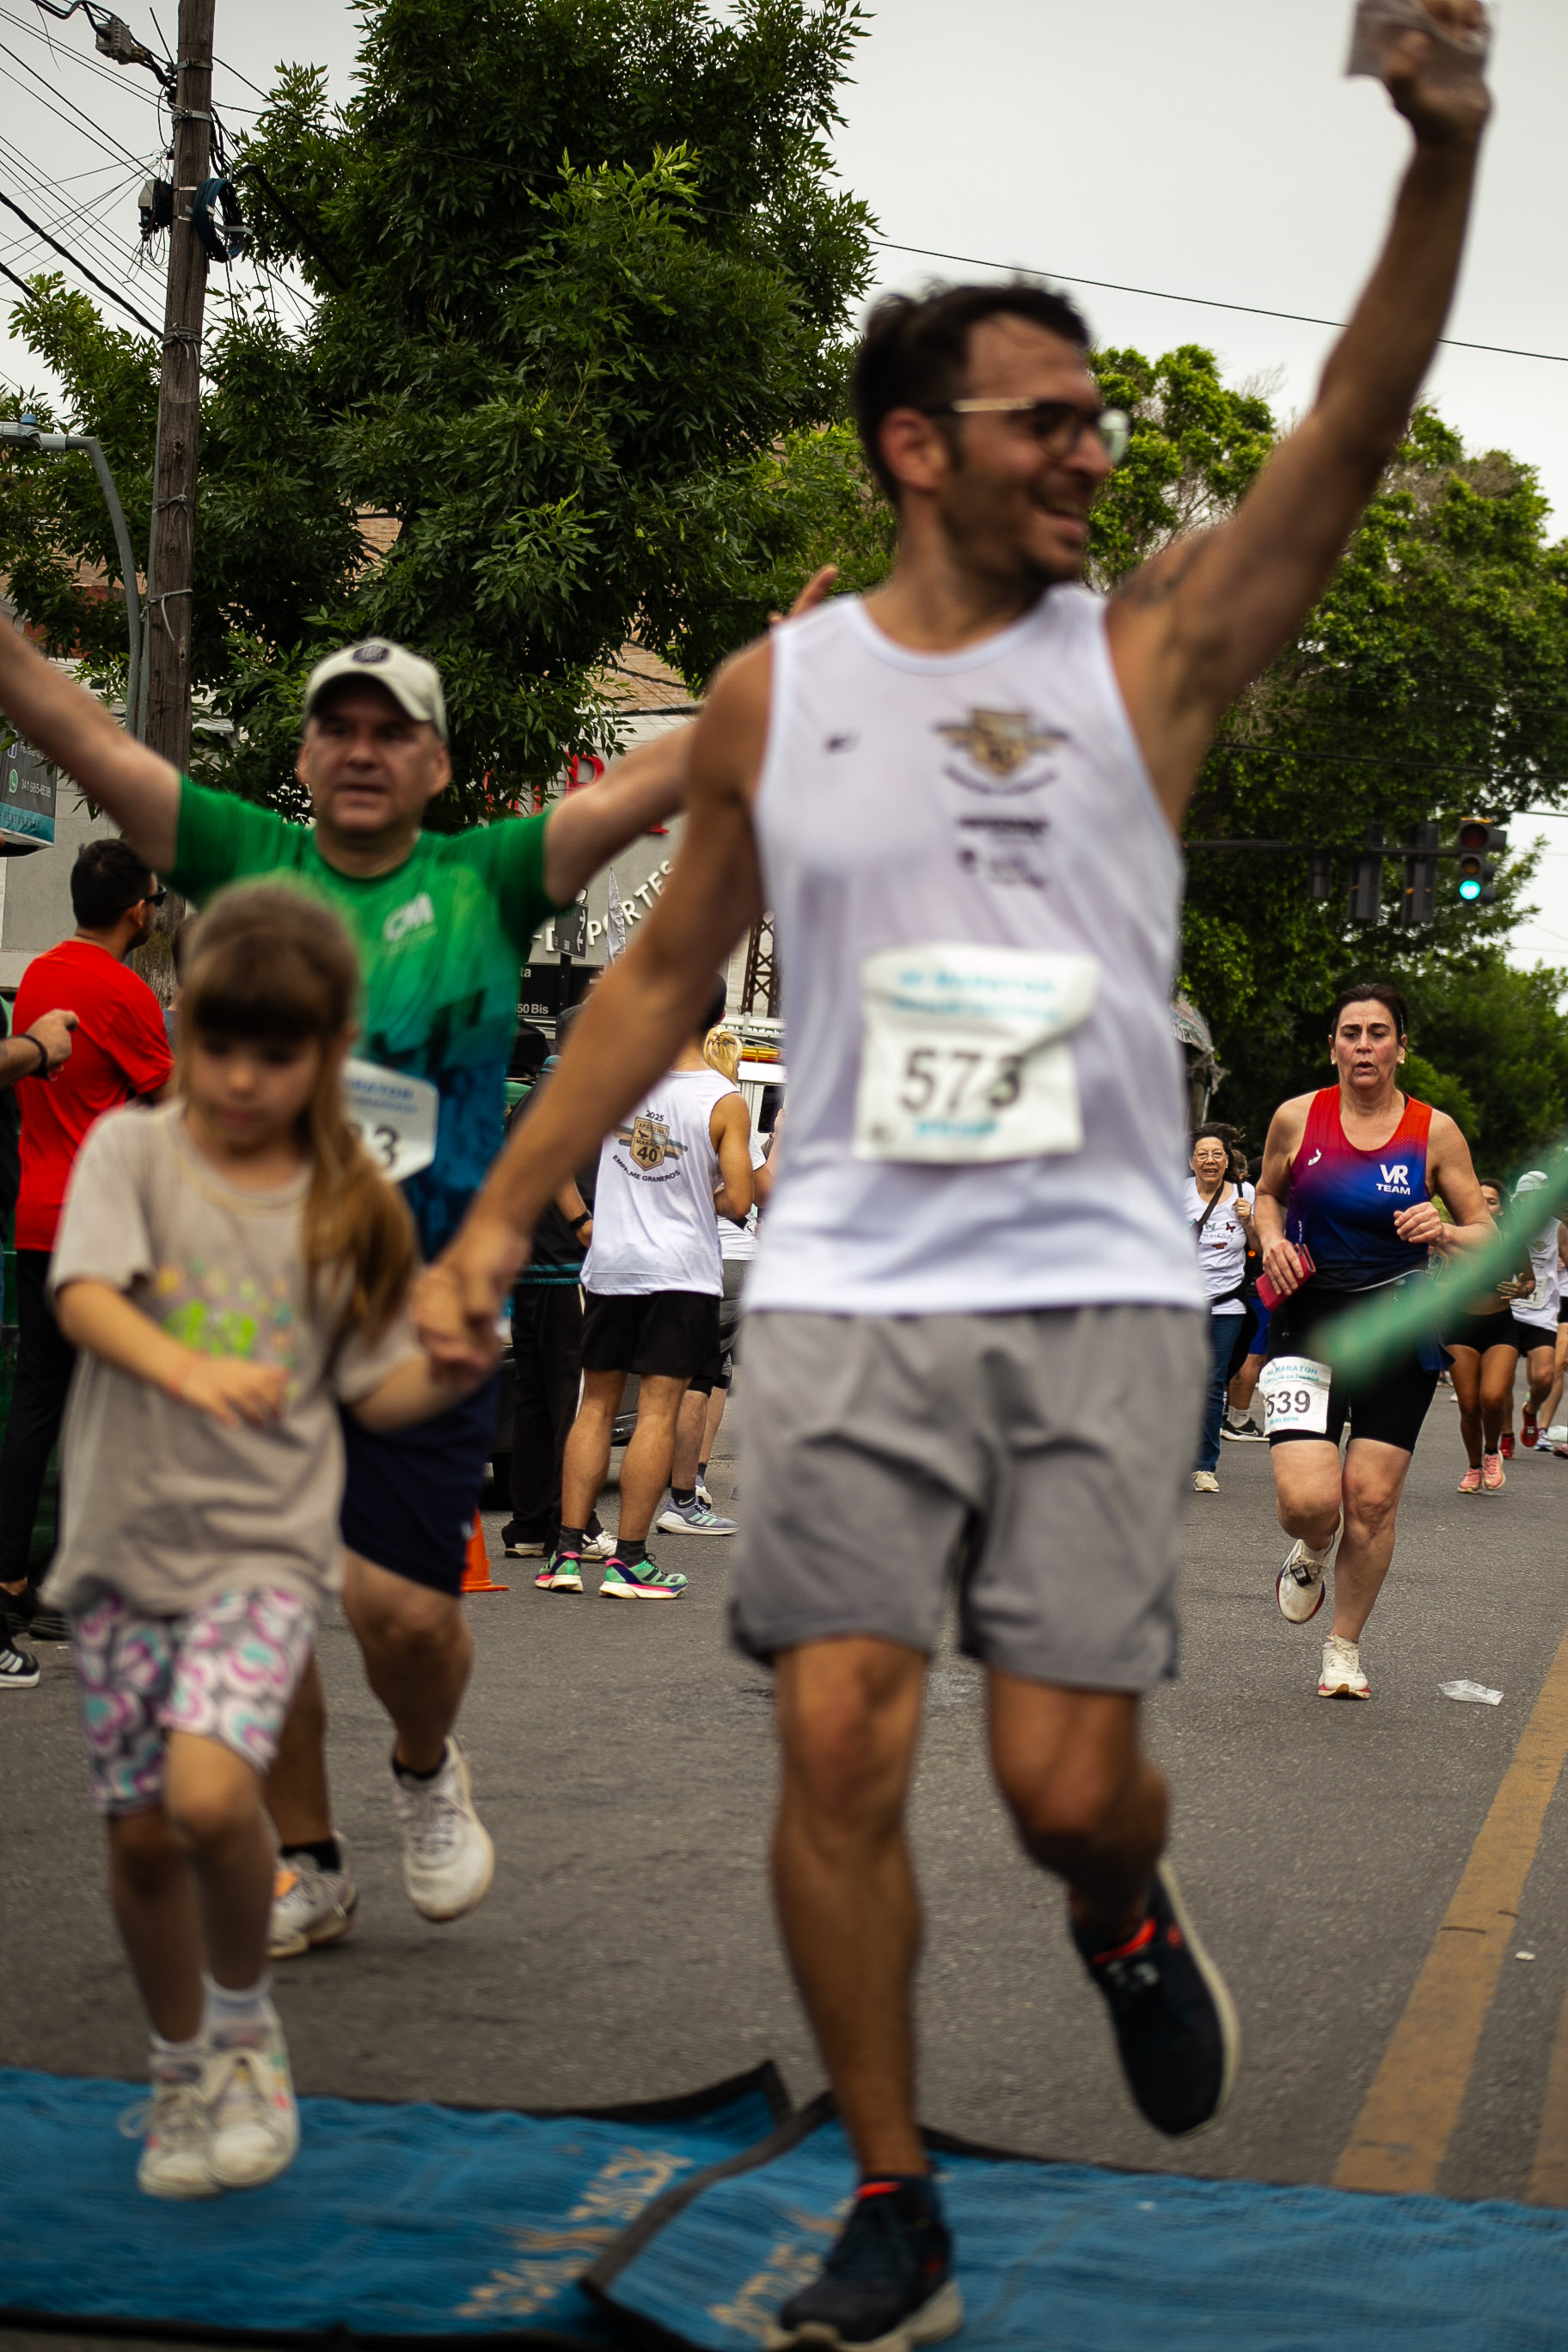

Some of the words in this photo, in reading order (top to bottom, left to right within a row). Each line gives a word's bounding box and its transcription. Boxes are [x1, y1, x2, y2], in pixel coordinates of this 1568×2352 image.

[530, 1004, 549, 1014] Bis
[901, 1047, 1022, 1112] 573
[646, 1111, 664, 1122] 2025
[637, 1147, 658, 1162] 40
[613, 1155, 640, 1179] EMPALME
[642, 1170, 680, 1182] GRANEROS
[1379, 1164, 1409, 1185] VR
[1375, 1183, 1411, 1196] TEAM
[1265, 1389, 1311, 1418] 539
